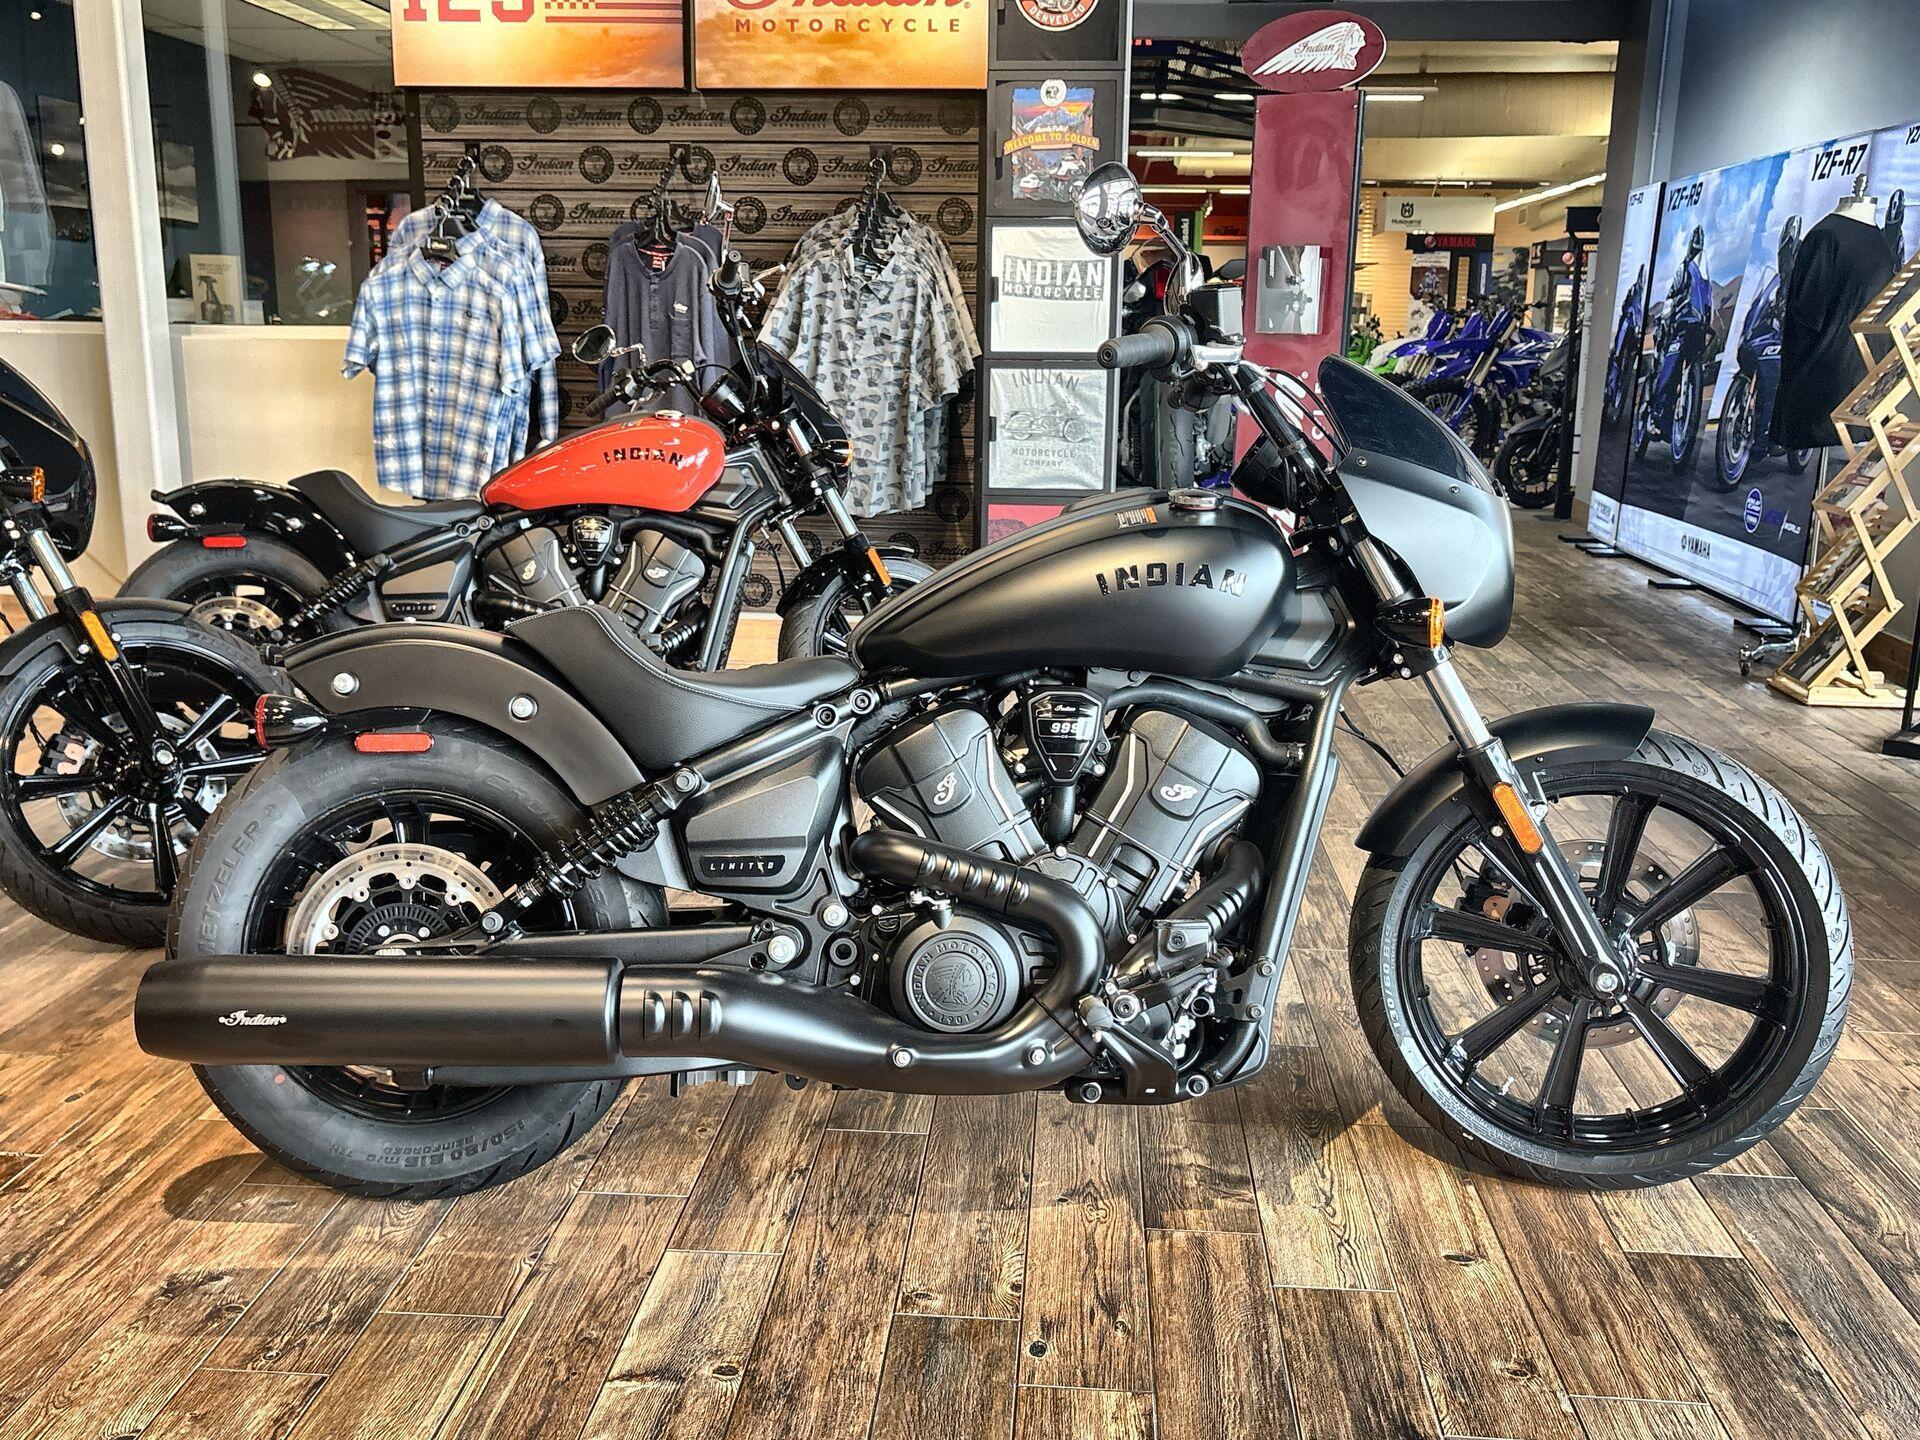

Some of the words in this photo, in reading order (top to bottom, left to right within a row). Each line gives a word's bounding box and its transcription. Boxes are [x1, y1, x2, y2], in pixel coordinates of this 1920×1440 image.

[734, 18, 961, 33] MOTORCYCLE
[1293, 42, 1335, 55] Indian
[464, 103, 521, 120] Indian
[566, 104, 623, 121] Indian
[668, 105, 725, 122] Indian
[770, 105, 828, 122] Indian
[874, 105, 933, 123] Indian
[1006, 134, 1047, 151] WELCOME
[1050, 132, 1062, 141] TO
[1064, 133, 1099, 147] GOLDEN
[517, 154, 574, 171] Indian
[720, 155, 777, 172] Indian
[926, 156, 978, 173] India
[1810, 144, 1869, 182] YZF-R7
[1667, 181, 1704, 212] YZF-R9
[569, 202, 625, 219] Indian
[1436, 236, 1477, 248] YAMAHA
[1003, 257, 1103, 287] INDIAN
[1003, 281, 1102, 299] MOTORCYCLE
[1012, 369, 1080, 392] INDIAN
[603, 447, 685, 467] INDIAN
[1012, 447, 1077, 458] MOTORCYCLE
[1023, 459, 1074, 468] COMPANY
[1687, 535, 1712, 560] YAMAHA
[1095, 562, 1248, 598] INDIAN
[709, 861, 775, 872] LIMITED
[223, 1009, 281, 1027] Indian
